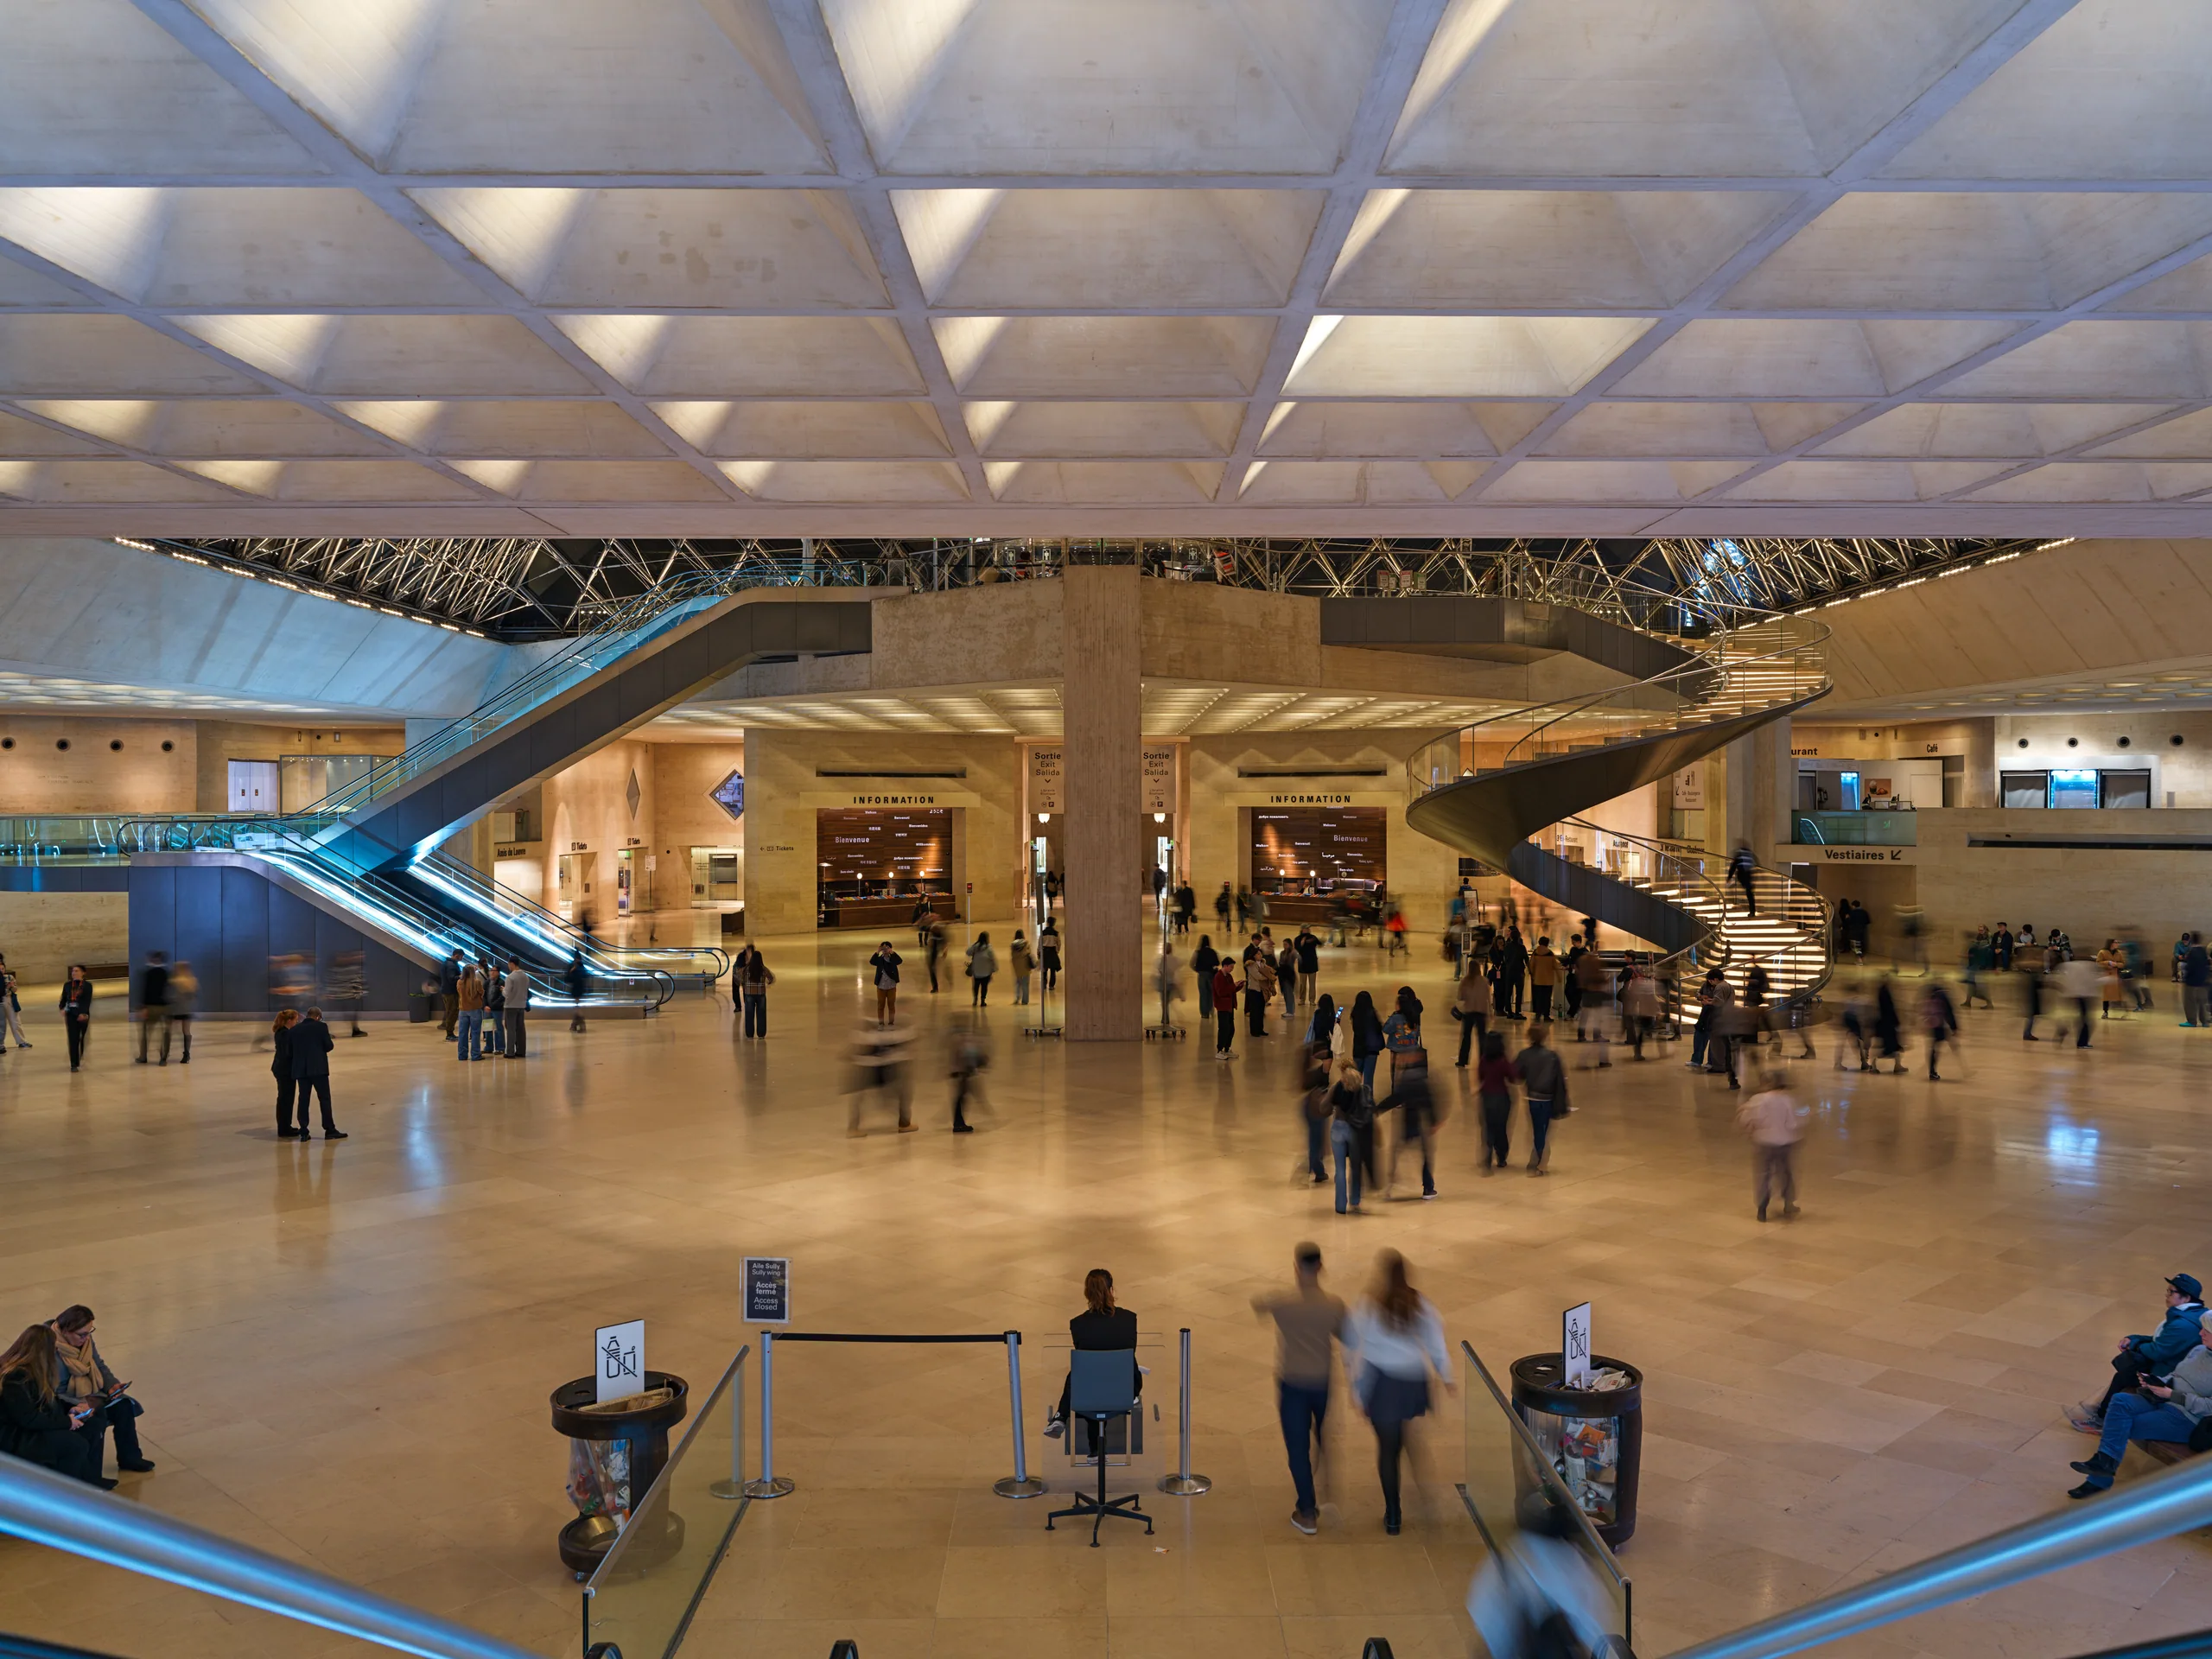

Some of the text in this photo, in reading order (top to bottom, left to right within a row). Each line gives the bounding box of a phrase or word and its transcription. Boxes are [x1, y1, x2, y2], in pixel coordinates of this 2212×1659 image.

[1926, 743, 1938, 753] Café
[497, 848, 507, 857] Amis
[513, 847, 525, 855] Louvre
[1825, 849, 1885, 860] Vestiaires
